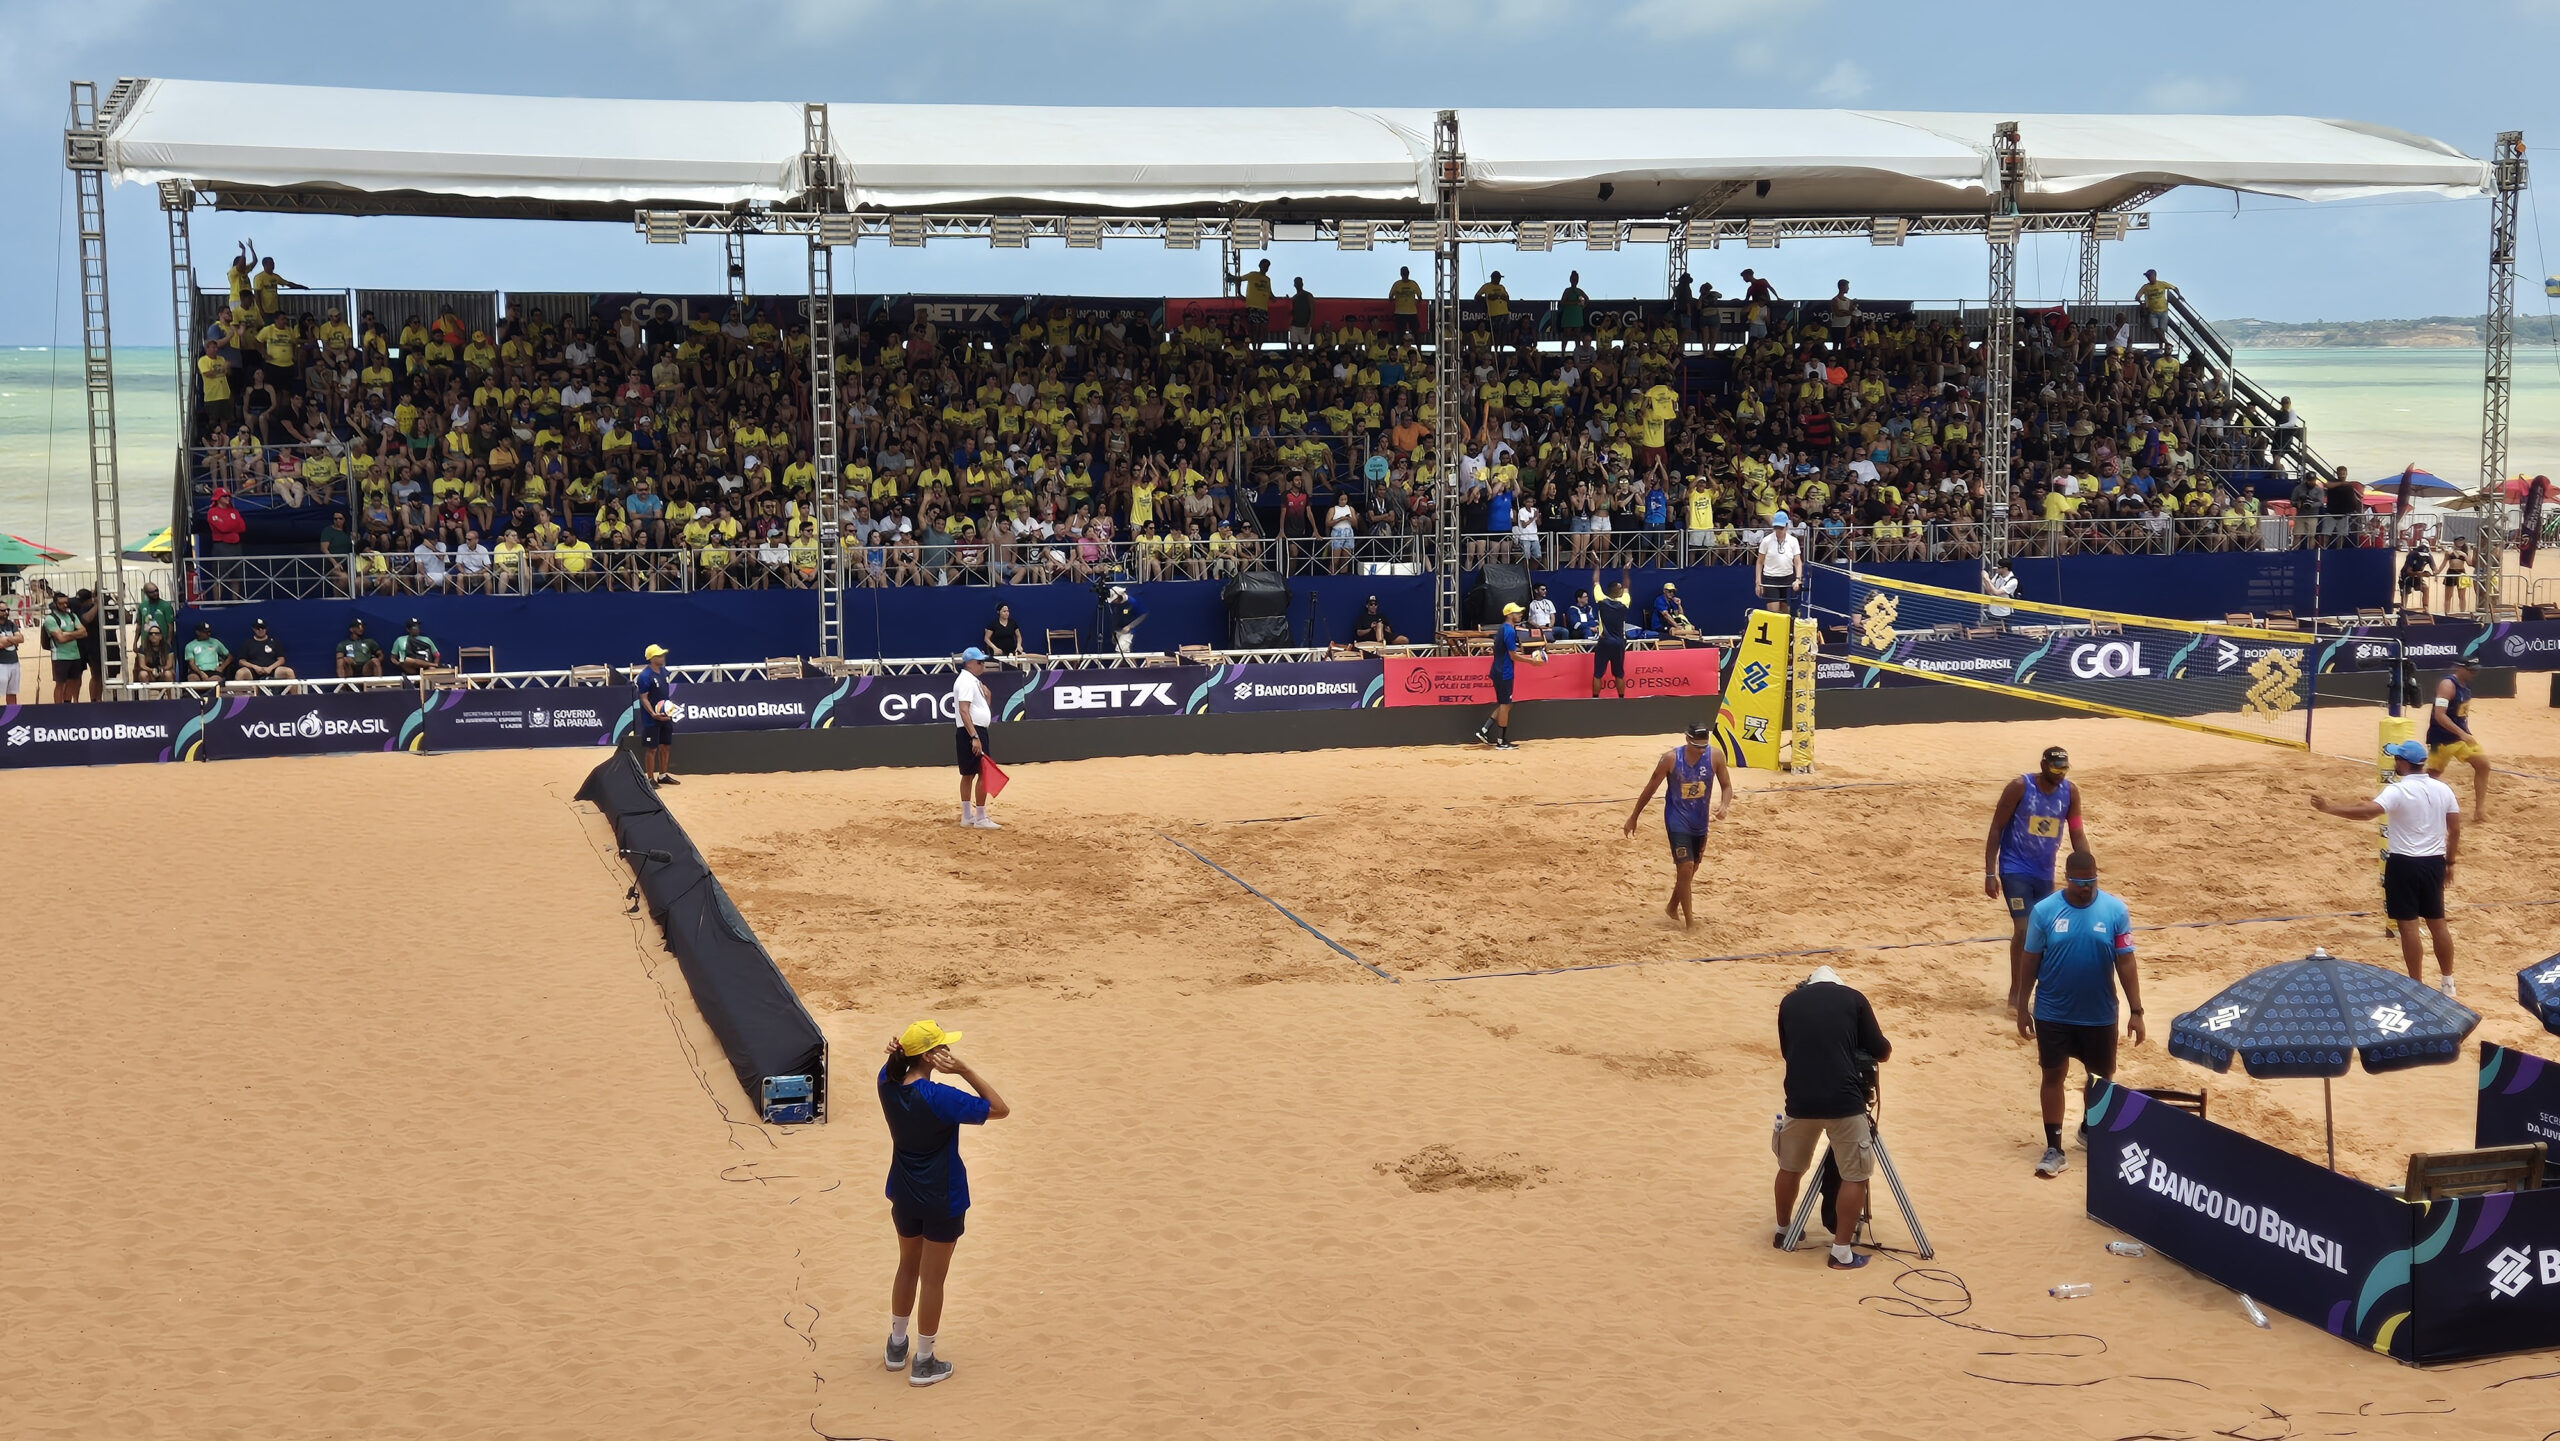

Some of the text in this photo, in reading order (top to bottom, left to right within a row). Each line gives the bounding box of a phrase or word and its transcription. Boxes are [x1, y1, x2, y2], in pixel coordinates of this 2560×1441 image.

[630, 298, 696, 326] GOL
[914, 303, 1000, 321] BET7K
[1754, 622, 1773, 646] 1
[2409, 646, 2424, 656] DO
[2423, 644, 2458, 656] BRASIL
[2525, 637, 2556, 651] VÔLEI
[1817, 663, 1850, 671] GOVERNO
[1920, 658, 2012, 671] BANCO DO BRASIL
[2070, 641, 2150, 679] GOL
[1635, 666, 1664, 674] ETAPA
[1254, 681, 1358, 697] BANCO DO BRASIL
[1601, 677, 1690, 690] JOO PESSOA
[1053, 682, 1177, 710] BET7K
[553, 709, 596, 719] GOVERNO
[687, 701, 805, 720] BANCO DO BRASIL
[241, 718, 389, 738] VÔLEI BRASIL
[553, 718, 566, 728] DA
[1745, 716, 1769, 728] BET
[34, 724, 168, 743] BANCO DO BRASIL
[1742, 725, 1767, 743] 7K
[2527, 1122, 2541, 1135] DA
[2149, 1158, 2348, 1275] BANCO DO BRASIL
